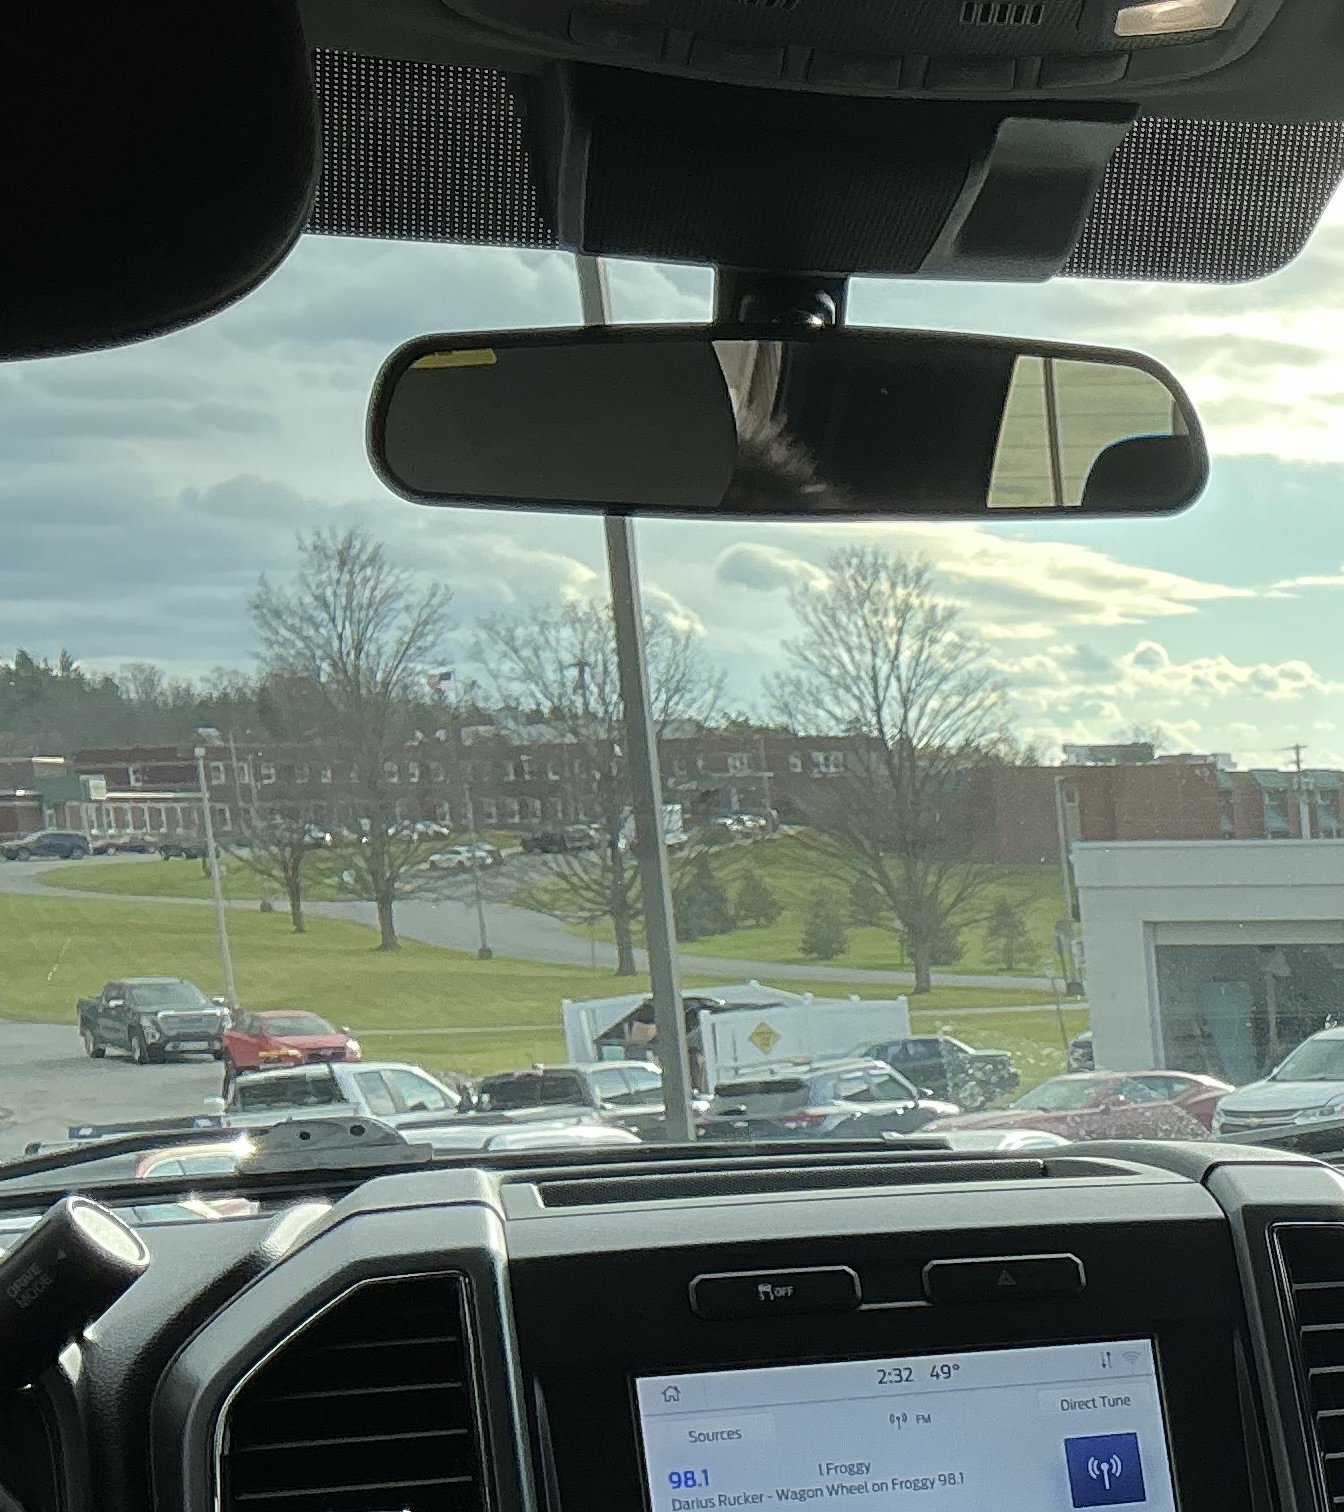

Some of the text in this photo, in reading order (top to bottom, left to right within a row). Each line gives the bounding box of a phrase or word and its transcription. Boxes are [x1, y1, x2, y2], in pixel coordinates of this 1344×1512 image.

[774, 1286, 795, 1298] OFF
[877, 1367, 914, 1385] 2:32
[1060, 1395, 1132, 1412] Direct Tune
[915, 1413, 932, 1425] FM
[687, 1429, 743, 1444] Sources
[826, 1461, 871, 1477] Froggy
[667, 1469, 711, 1489] 98.1
[671, 1494, 717, 1512] Darius
[717, 1491, 765, 1508] Rucker
[775, 1485, 824, 1502] Wagon
[827, 1481, 870, 1496] Wheel
[871, 1482, 889, 1494] on
[891, 1475, 936, 1491] Froggy
[937, 1471, 965, 1486] 98.1
